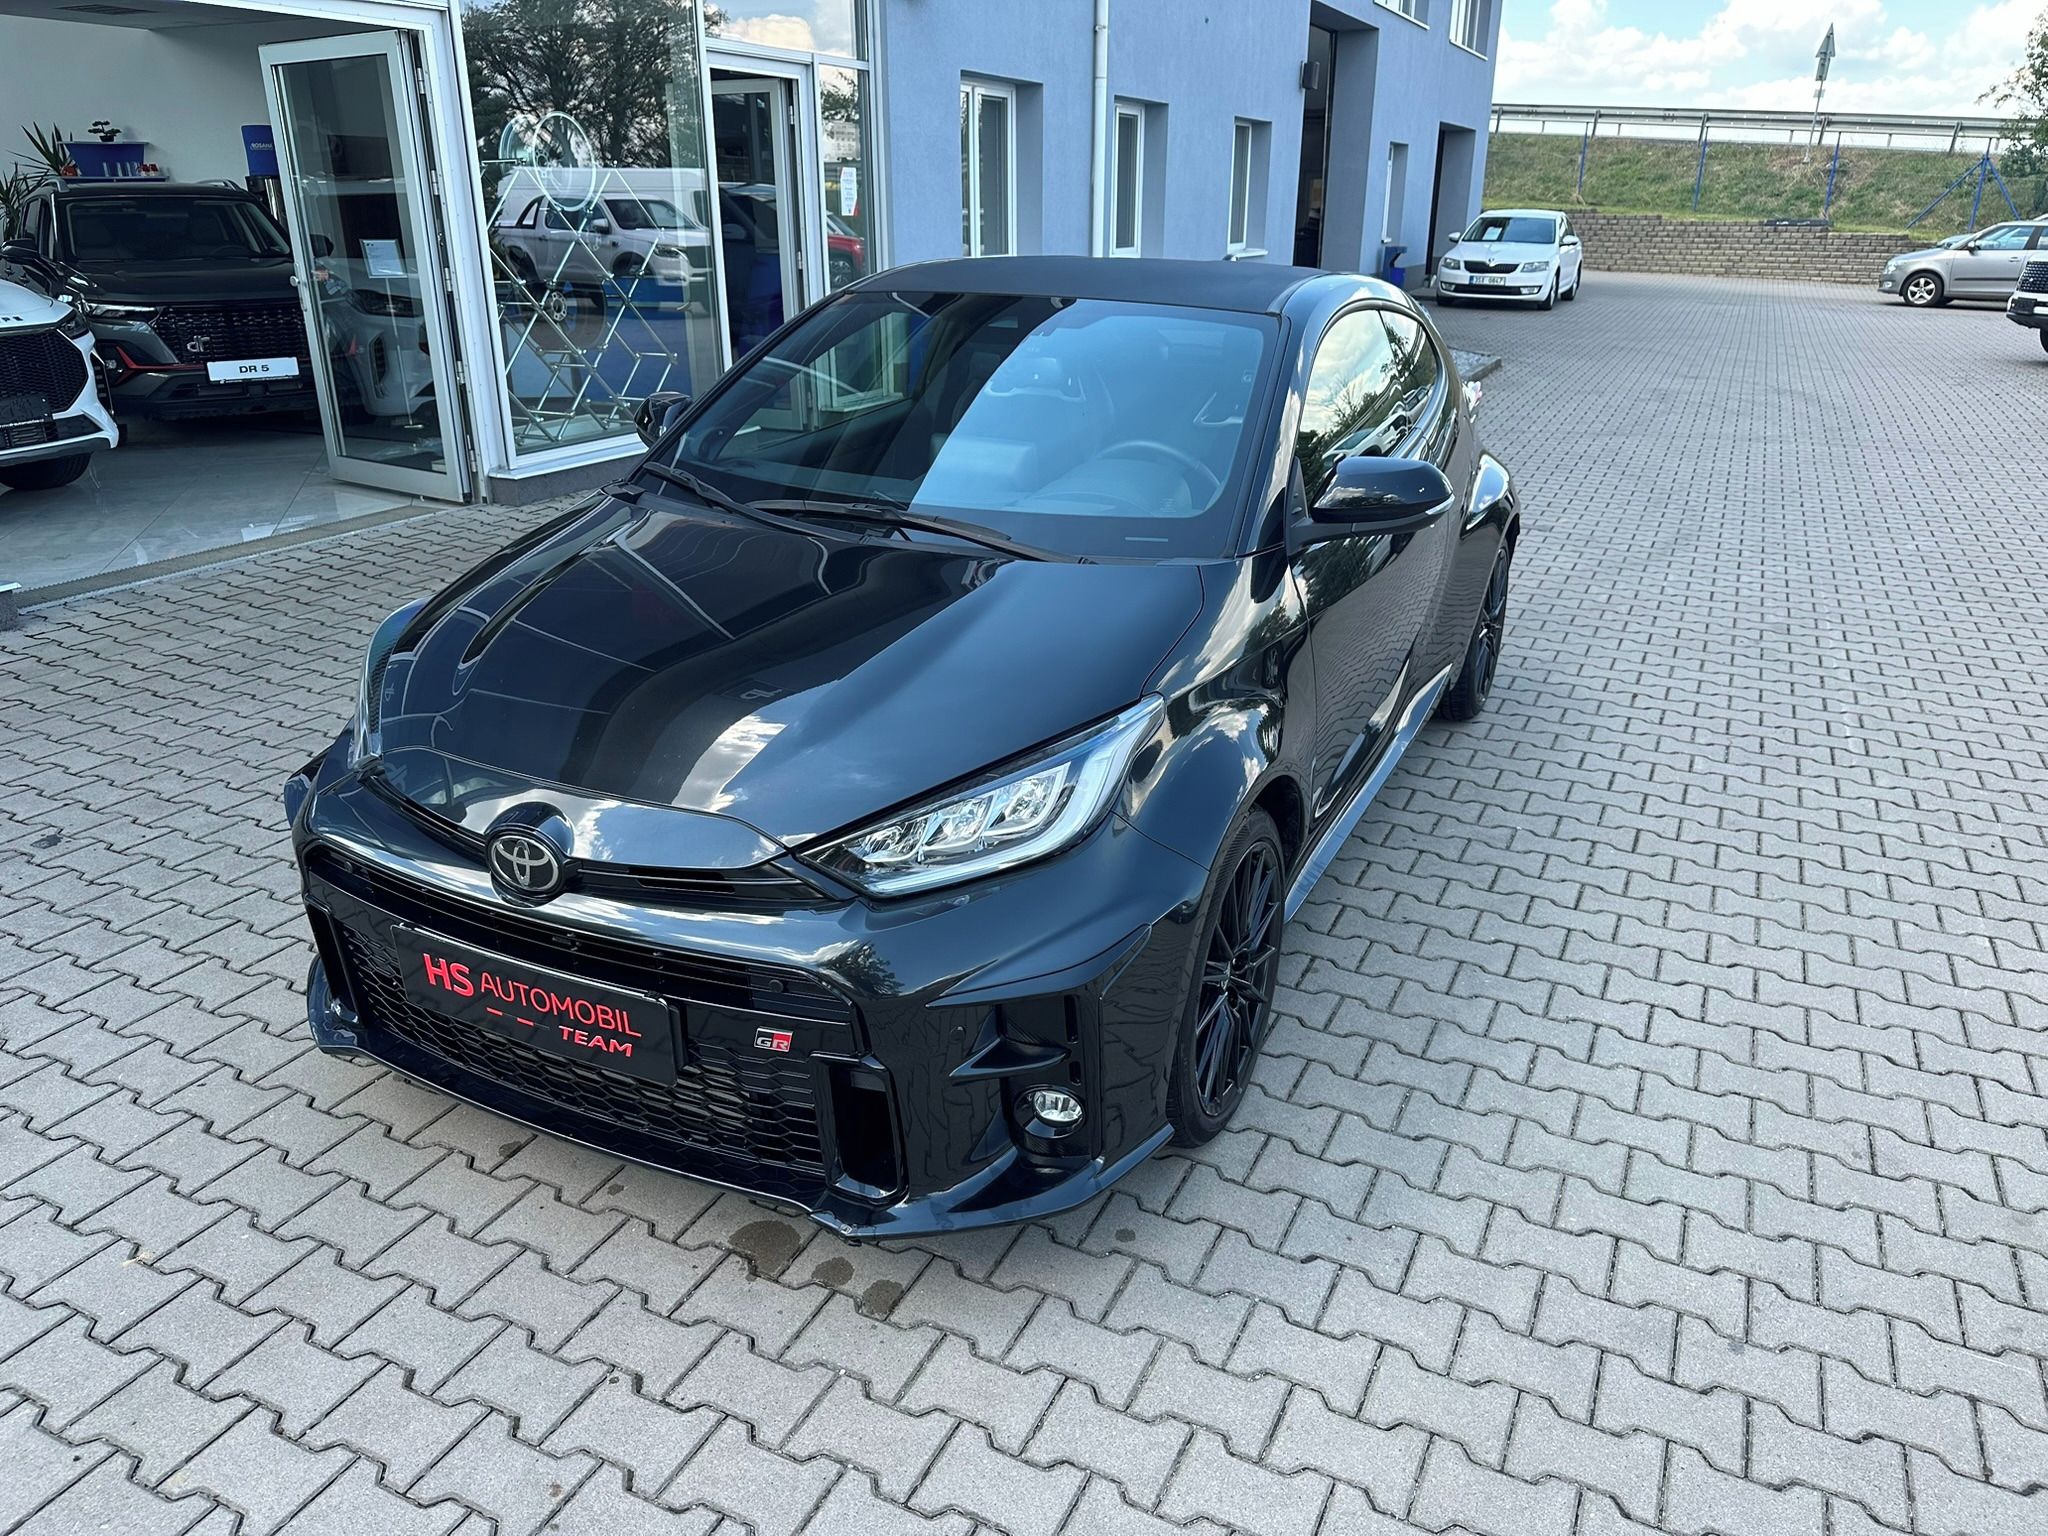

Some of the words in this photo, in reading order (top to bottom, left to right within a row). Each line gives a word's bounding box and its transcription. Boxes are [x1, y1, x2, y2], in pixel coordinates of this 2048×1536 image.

[239, 364, 258, 374] DR
[261, 364, 270, 372] 5
[423, 953, 474, 997] HS
[480, 972, 642, 1037] AUTOMOBIL
[558, 1025, 633, 1057] TEAM
[756, 1035, 790, 1050] GR
